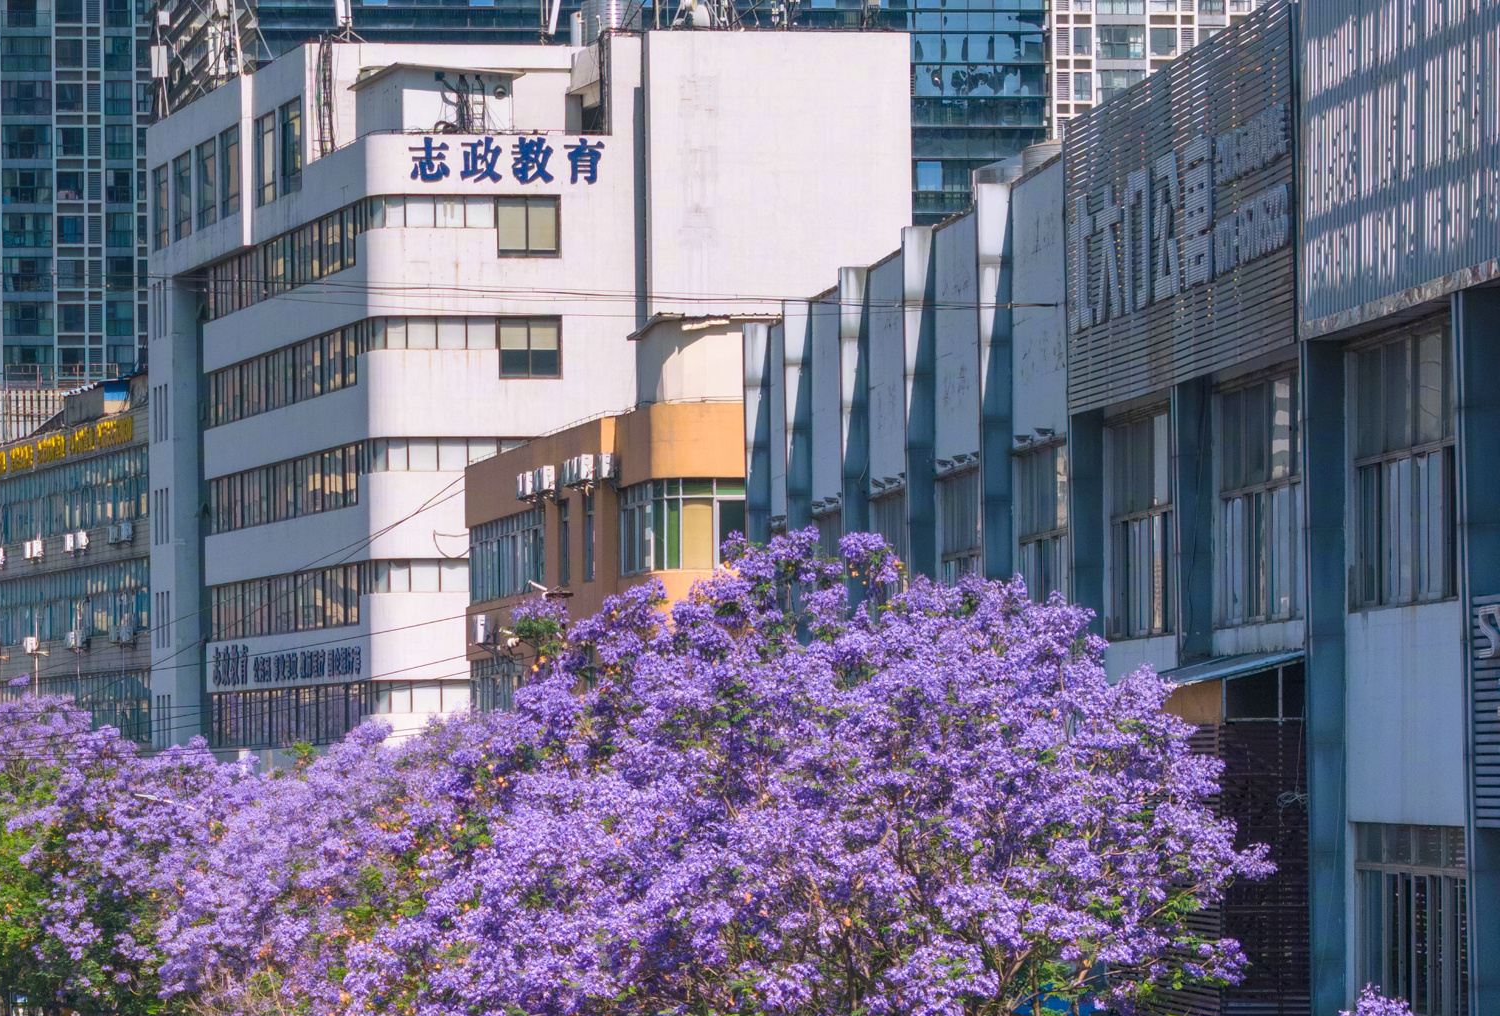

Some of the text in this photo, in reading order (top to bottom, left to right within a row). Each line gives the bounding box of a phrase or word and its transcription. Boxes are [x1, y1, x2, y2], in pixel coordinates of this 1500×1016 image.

[408, 136, 605, 185] 志政教育
[213, 644, 248, 686] 志政教育
